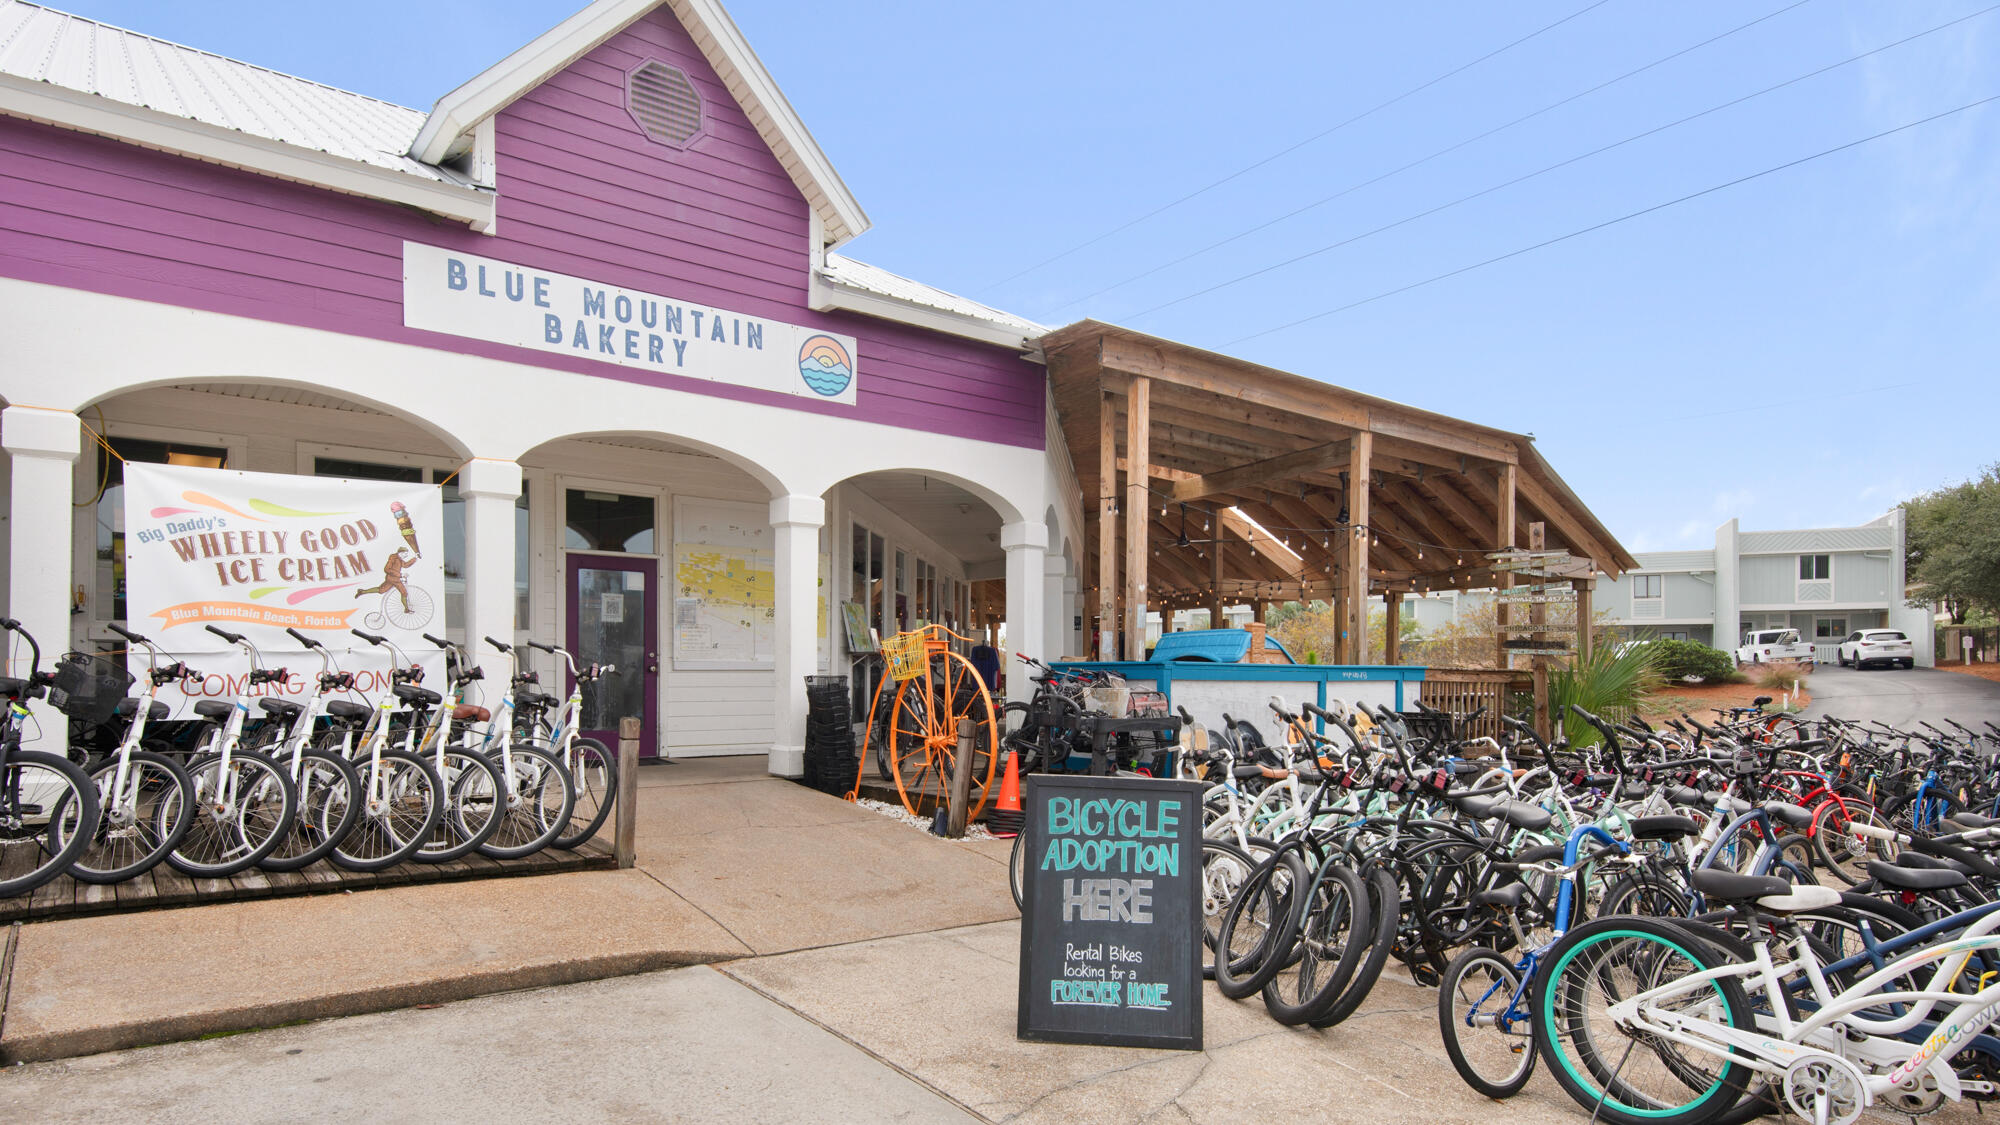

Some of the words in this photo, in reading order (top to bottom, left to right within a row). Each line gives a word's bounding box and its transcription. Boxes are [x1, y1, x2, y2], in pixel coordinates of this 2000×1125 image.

[447, 258, 551, 308] BLUE
[583, 286, 764, 350] MOUNTAIN
[544, 313, 688, 367] BAKERY
[137, 528, 165, 544] Big
[166, 516, 227, 535] Daddy's
[168, 529, 289, 563] WHEELY
[300, 518, 378, 553] GOOD
[214, 558, 268, 586] ICE
[277, 550, 374, 582] CREAM
[171, 608, 199, 620] Blue
[202, 605, 260, 619] Mountain
[263, 610, 301, 625] Beach,
[304, 615, 341, 626] Florida
[180, 672, 306, 697] COMING
[1048, 796, 1181, 838] BICYCLE
[1041, 838, 1180, 876] ADOPTION
[1063, 878, 1154, 924] HERE
[1066, 942, 1102, 961] Rental
[1109, 945, 1143, 963] Bikes
[1064, 961, 1105, 982] looking
[1110, 964, 1125, 980] for
[1128, 969, 1137, 980] a
[1051, 979, 1121, 1004] FOREVER
[1127, 981, 1172, 1007] HOME.
